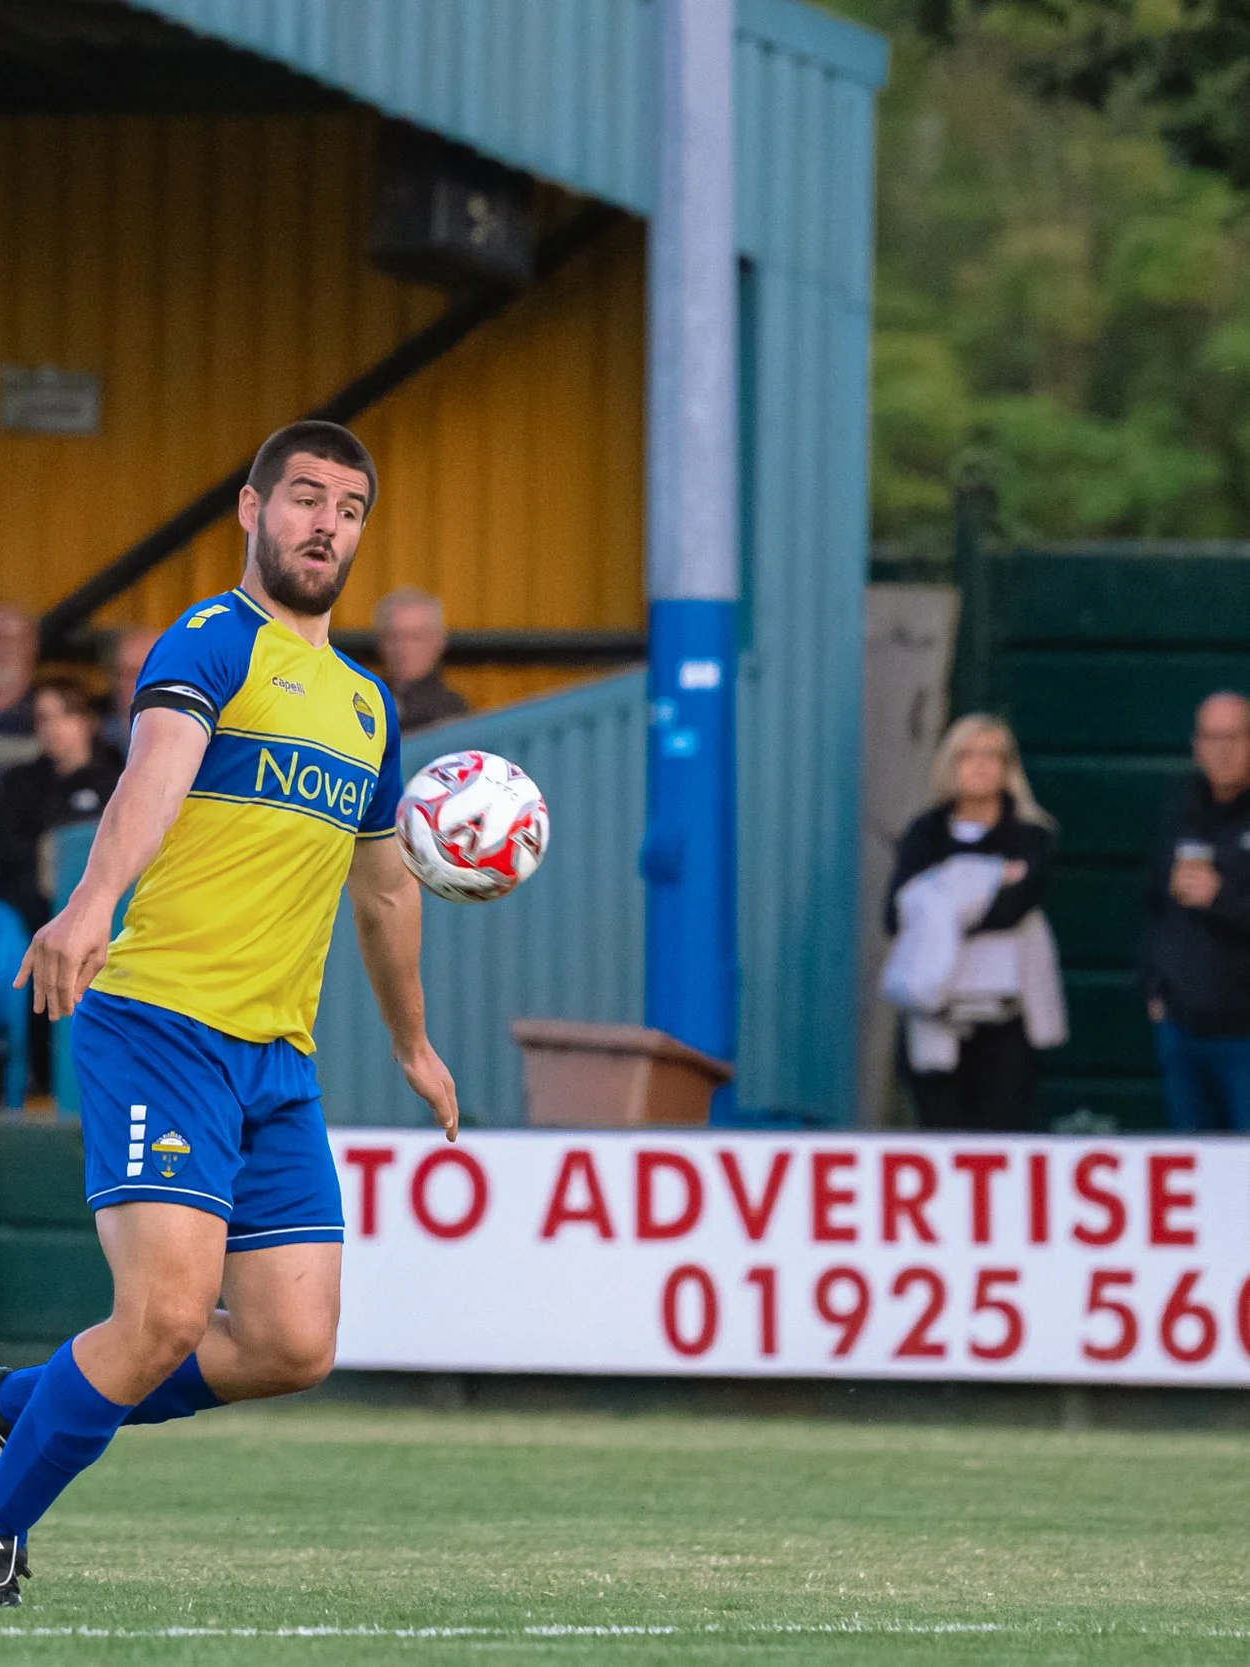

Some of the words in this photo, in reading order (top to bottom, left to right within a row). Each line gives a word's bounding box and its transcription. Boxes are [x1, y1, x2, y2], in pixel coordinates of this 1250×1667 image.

[344, 1147, 489, 1240] TO
[541, 1149, 1197, 1247] ADVERTISE
[661, 1264, 1023, 1361] 01925
[1085, 1270, 1250, 1364] 56
